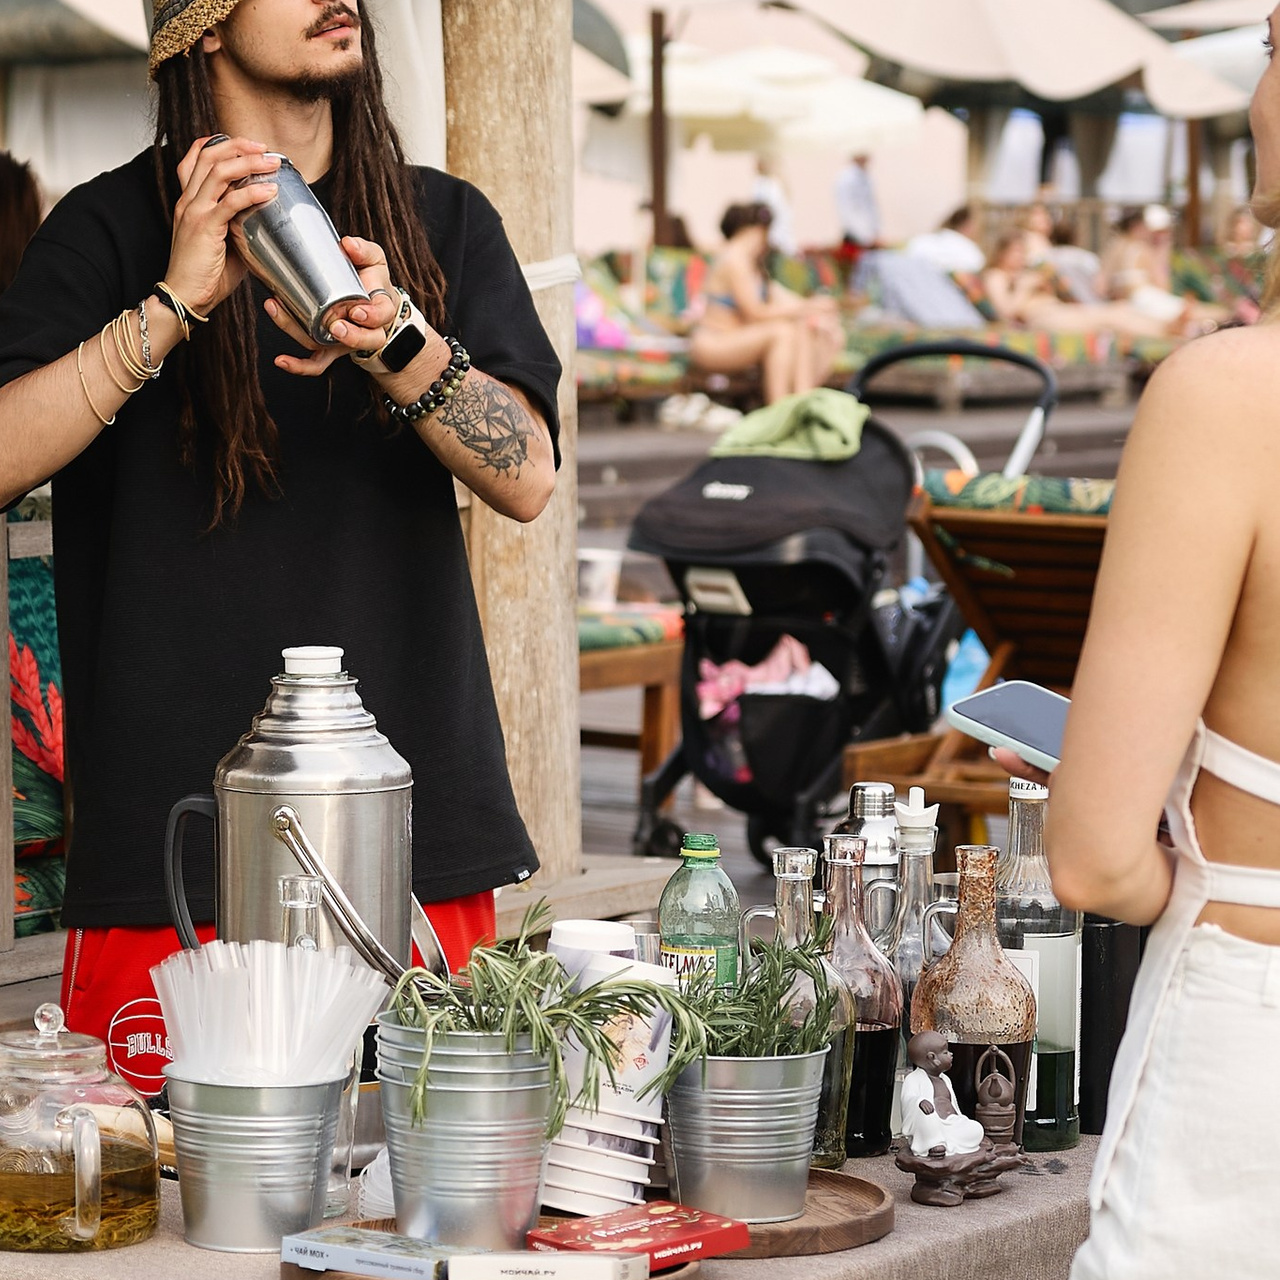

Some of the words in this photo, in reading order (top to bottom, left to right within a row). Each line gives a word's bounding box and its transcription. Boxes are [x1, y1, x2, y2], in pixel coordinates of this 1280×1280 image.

[126, 1032, 174, 1061] BULLS
[294, 1247, 308, 1256] ЧАЙ
[310, 1249, 325, 1259] МОХ
[653, 1240, 703, 1260] МОЙЧАЙ.РУ
[500, 1268, 556, 1277] МОЙЧАЙ.РУ
